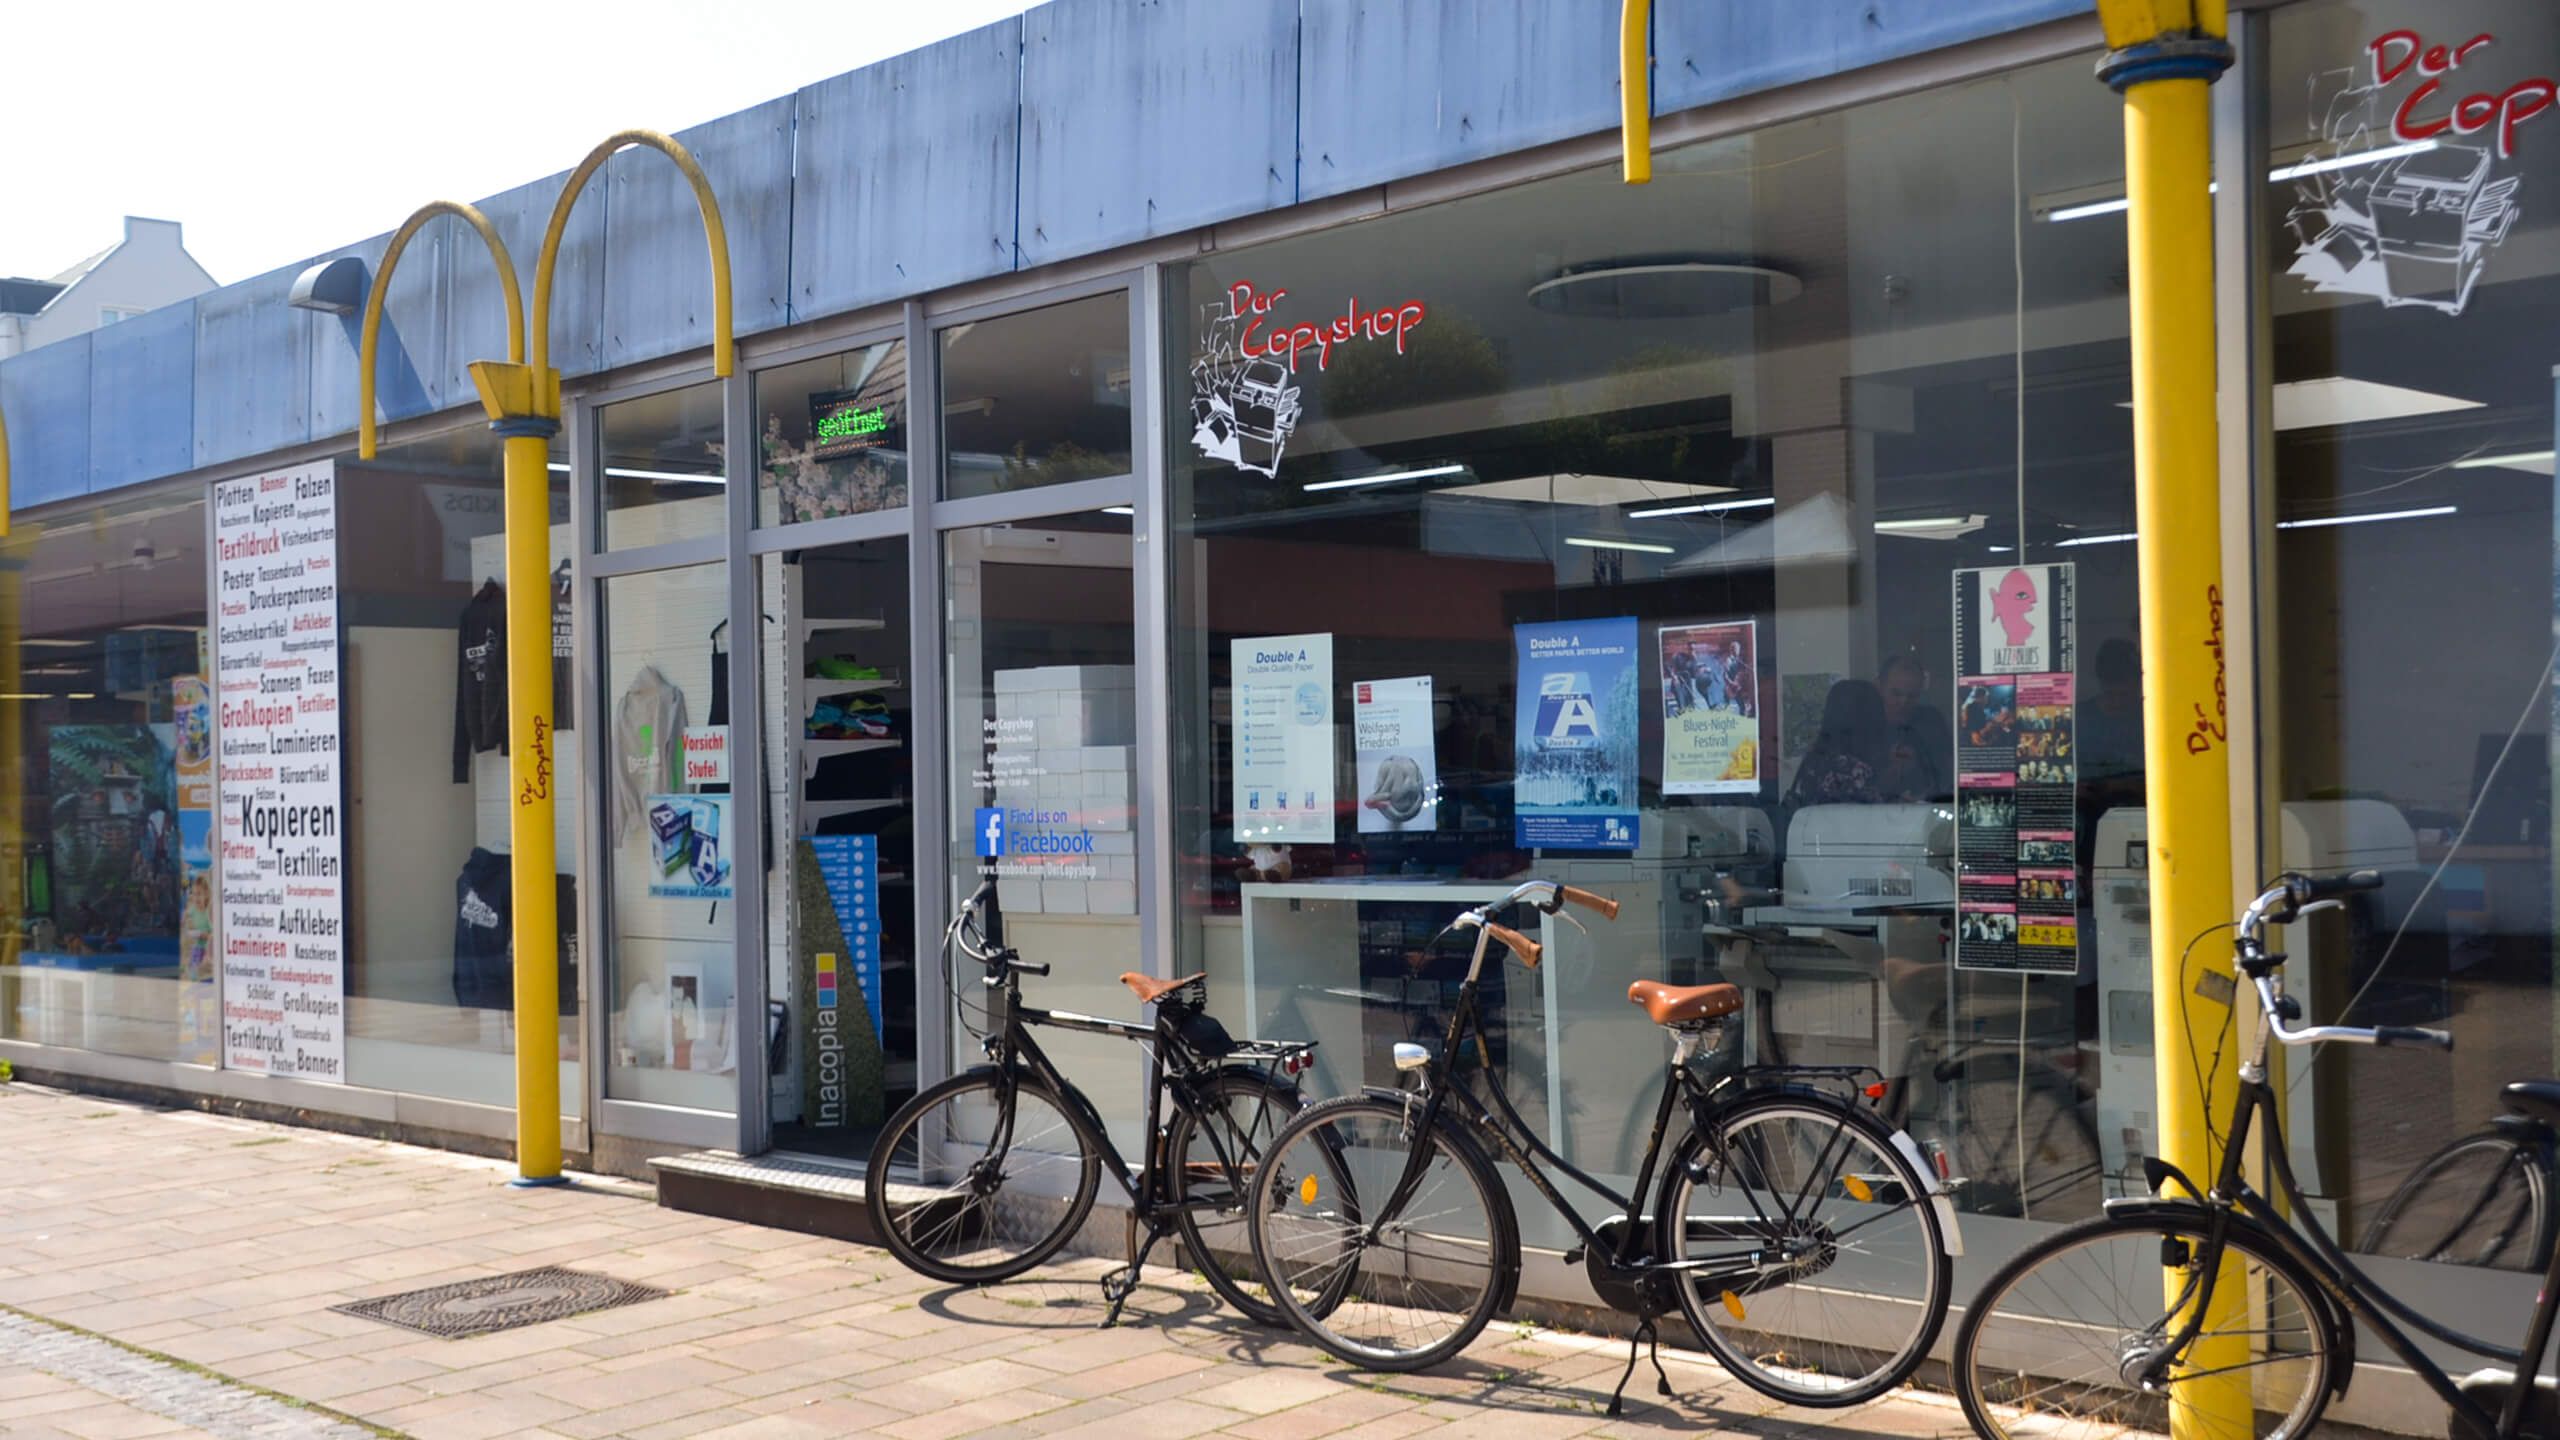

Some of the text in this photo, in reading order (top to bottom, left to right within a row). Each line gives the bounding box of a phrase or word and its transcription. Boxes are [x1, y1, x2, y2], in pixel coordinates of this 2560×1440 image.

[2364, 28, 2494, 89] Der
[2389, 77, 2560, 160] Cop
[1228, 280, 1288, 319] Der
[1240, 296, 1425, 375] Copyshop
[818, 404, 887, 445] geöffnet
[260, 476, 288, 493] Banner
[296, 473, 331, 501] Falzen
[217, 484, 255, 509] Plotten
[254, 500, 295, 528] Kopieren
[218, 527, 279, 561] Textildruck
[282, 526, 335, 547] Visitenkarten
[223, 568, 254, 592] Poster
[258, 560, 304, 583] Tassendruck
[250, 585, 334, 612] Druckerpatronen
[221, 618, 287, 645] Geschenkartikel
[293, 612, 332, 632] Aufkleber
[1530, 636, 1580, 650] Double A
[1530, 649, 1554, 659] BETTER
[1576, 646, 1601, 657] BETTER
[1601, 646, 1625, 655] WORLD
[220, 650, 263, 671] Büroartikel
[1247, 662, 1314, 674] Double Quality Paper
[1256, 649, 1306, 664] Double A
[2203, 584, 2226, 742] Copyshop
[260, 672, 302, 694] Scannen
[308, 665, 335, 685] Faxen
[297, 693, 336, 713] Textilien
[222, 698, 293, 733] Großkopien
[983, 717, 1034, 733] Der Copyshop
[1683, 717, 1739, 733] Blues-Night-
[1359, 721, 1400, 737] Wolfgang
[2187, 703, 2210, 756] Der
[223, 738, 267, 756] Keilrahmen
[270, 728, 336, 755] Laminieren
[682, 731, 723, 752] Vorsicht
[1359, 735, 1400, 749] Friedrich
[1694, 734, 1728, 748] Festival
[529, 714, 551, 799] Copyshop
[220, 762, 274, 781] Drucksachen
[280, 763, 329, 784] Büroartikel
[687, 759, 718, 778] Stufe!
[520, 777, 534, 806] Der
[242, 792, 335, 850] Kopieren
[1010, 808, 1067, 824] Find us on
[985, 813, 1001, 857] f
[1011, 828, 1094, 853] Facebook
[223, 840, 256, 860] Plotten
[276, 846, 338, 878] Textilien
[223, 887, 284, 905] Geschenkartikel
[232, 912, 274, 928] Drucksachen
[279, 908, 339, 936] Aufkleber
[226, 932, 287, 959] Laminieren
[295, 942, 337, 962] Kaschieren
[270, 965, 334, 987] Einladungskarten
[247, 983, 276, 1001] Schilder
[225, 1001, 284, 1027] Ringbindungen
[283, 991, 339, 1020] Großkopien
[226, 1024, 284, 1053] Textildruck
[291, 1023, 331, 1043] Tassendruck
[297, 1047, 339, 1075] Banner
[812, 1010, 844, 1127] Inacopia
